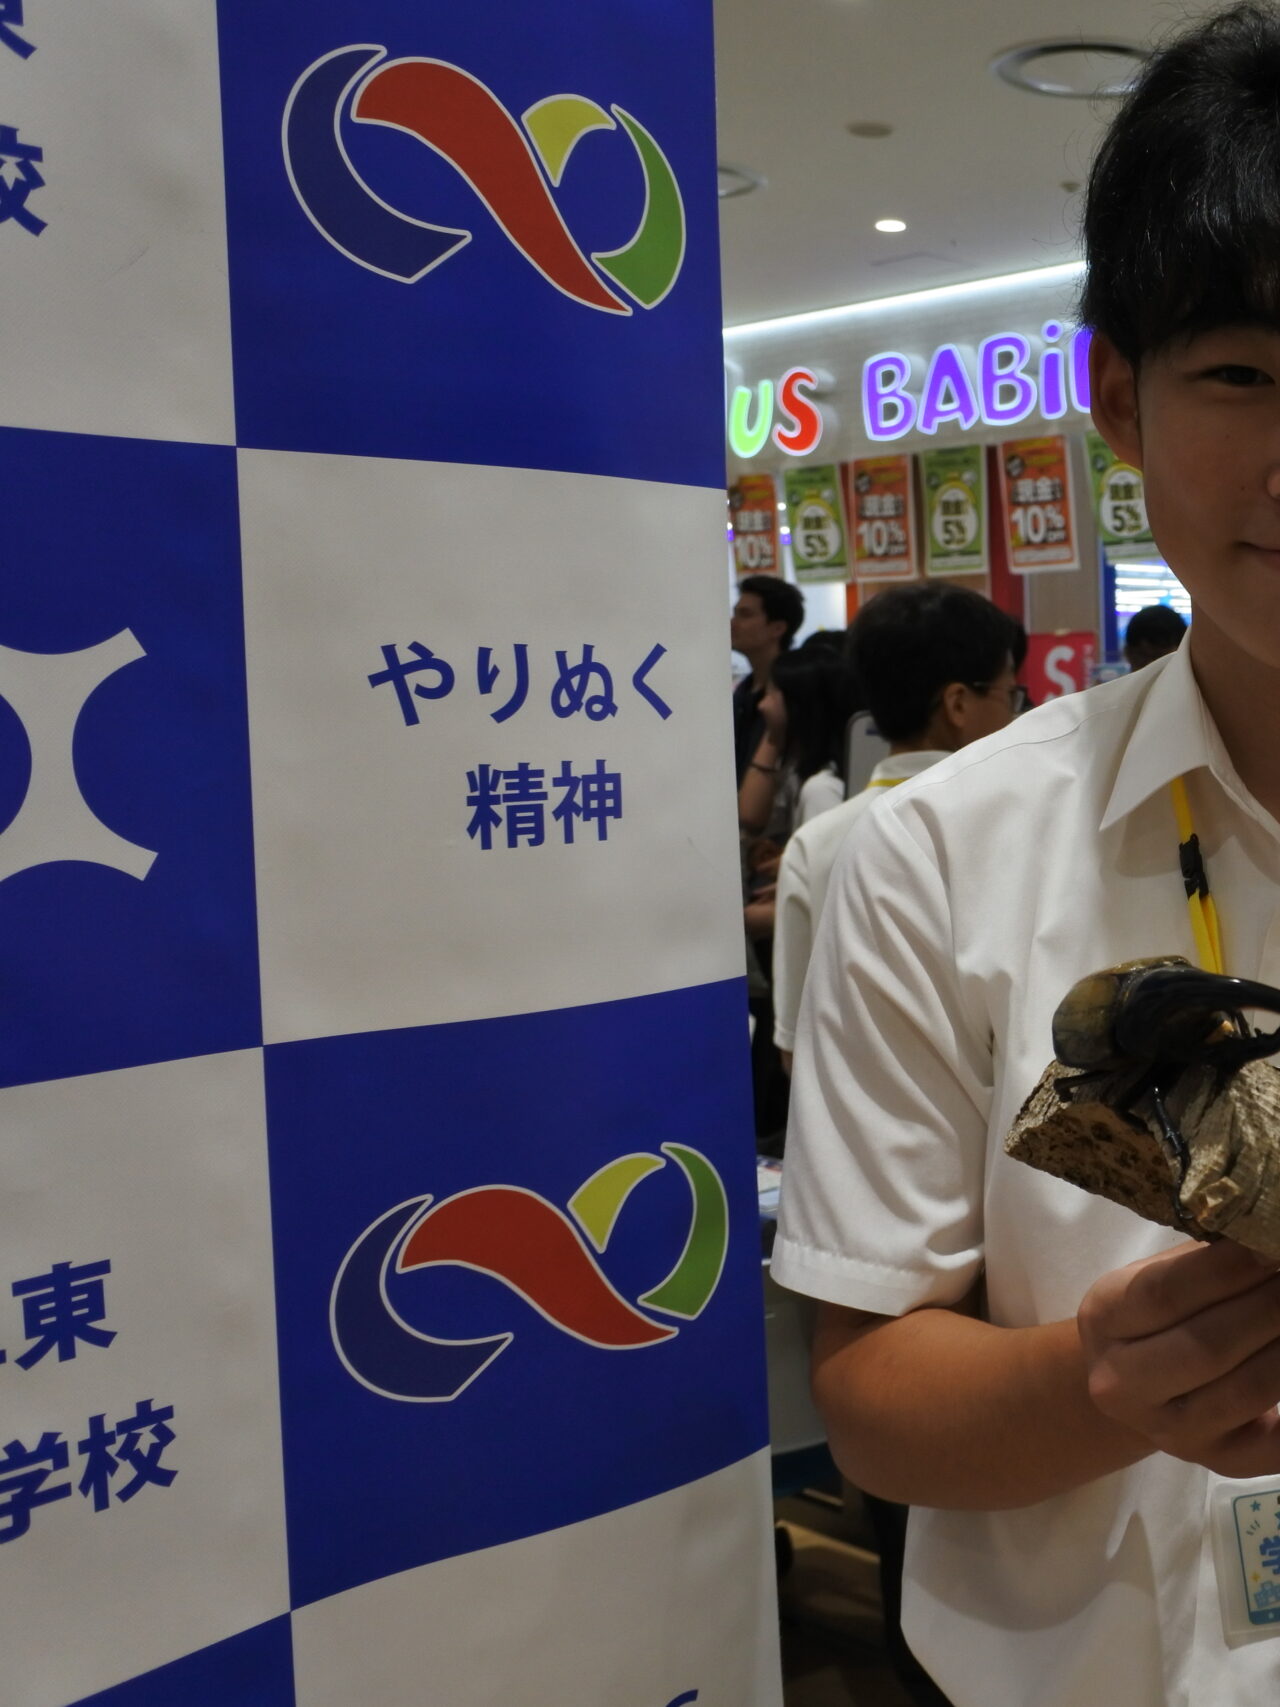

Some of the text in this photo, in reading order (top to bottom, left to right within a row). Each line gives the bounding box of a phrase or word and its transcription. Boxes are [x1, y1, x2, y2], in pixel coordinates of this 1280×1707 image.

[857, 520, 905, 556] 10%
[1012, 505, 1064, 543] 10%
[1112, 504, 1141, 531] 5%
[367, 641, 673, 726] やりぬく
[466, 759, 623, 850] 精神
[0, 1259, 118, 1371] 東
[0, 1398, 179, 1545] 学校
